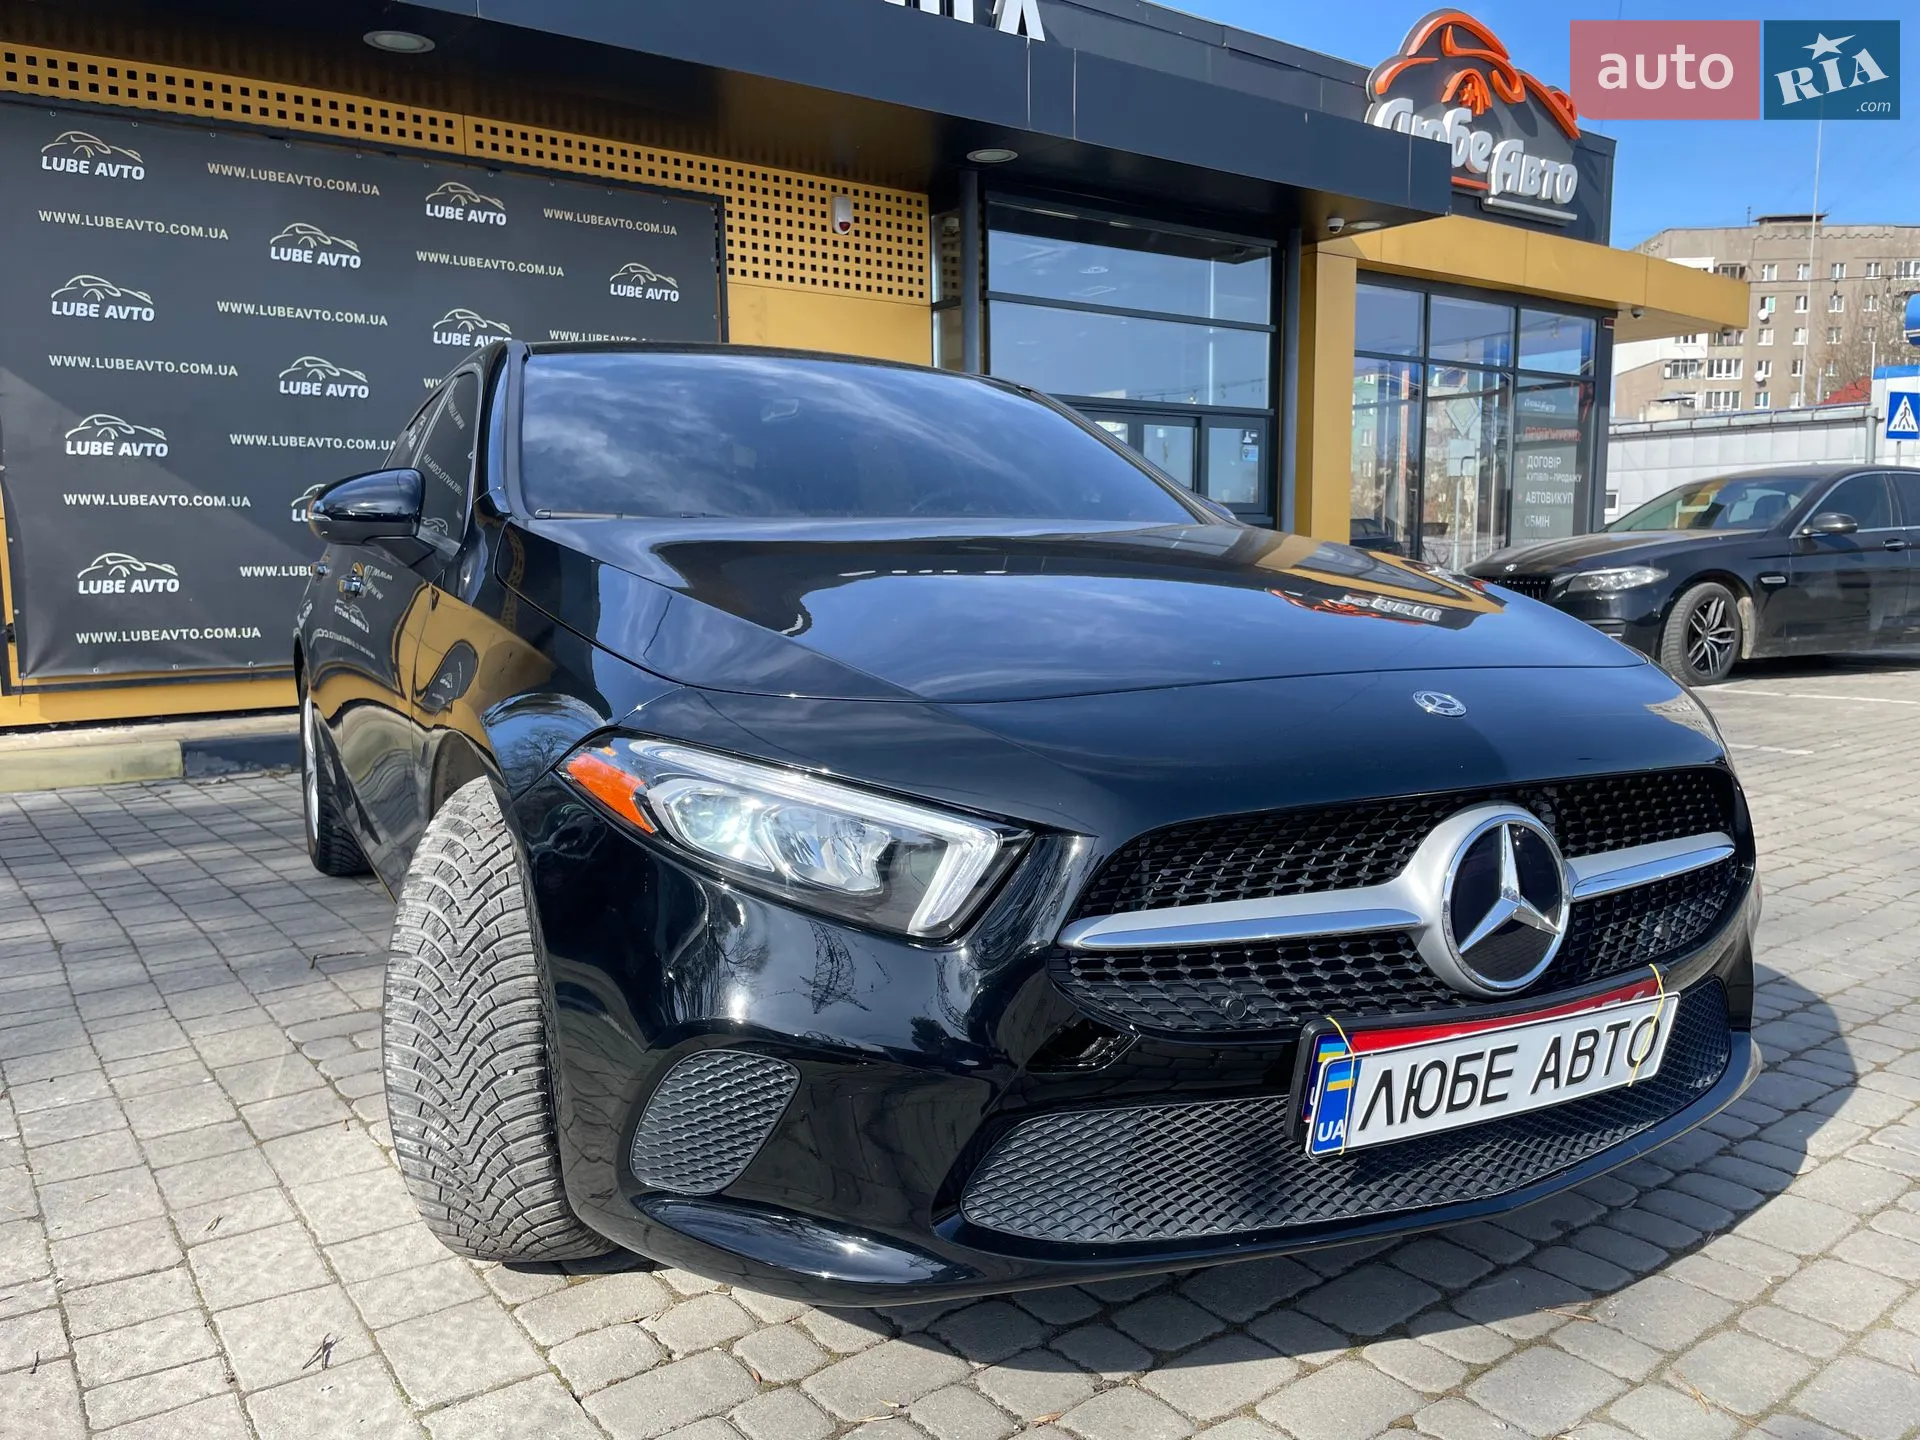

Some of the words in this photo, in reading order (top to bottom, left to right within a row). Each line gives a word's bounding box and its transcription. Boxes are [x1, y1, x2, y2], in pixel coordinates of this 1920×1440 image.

[41, 155, 89, 175] LUBE
[94, 162, 145, 181] AVTO
[207, 162, 380, 196] WWW.LUBEAVTO.COM.UA
[38, 210, 229, 241] WWW.LUBEAVTO.COM.UA
[425, 203, 465, 221] LUBE
[467, 209, 507, 226] AVTO
[543, 208, 678, 236] WWW.LUBEAVTO.COM.UA
[270, 247, 313, 264] LUBE
[317, 252, 362, 269] AVTO
[416, 251, 565, 277] WWW.LUBEAVTO.COM.UA
[610, 284, 643, 299] LUBE
[645, 287, 680, 303] AVTO
[51, 300, 99, 318] LUBE
[105, 305, 155, 322] AVTO
[217, 301, 388, 326] WWW.LUBEAVTO.COM.UA
[433, 331, 471, 347] LUBE
[48, 354, 238, 377] WWW.LUBEAVTO.COM.UA
[279, 380, 322, 397] LUBE
[325, 384, 370, 399] AVTO
[66, 440, 113, 456] LUBE
[118, 442, 169, 457] AVTO
[1526, 455, 1562, 470] ДОГОВІР
[63, 494, 251, 508] WWW.LUBEAVTO.COM.UA
[1525, 491, 1574, 505] АВТОВИКУП
[78, 579, 125, 595] LUBE
[130, 578, 180, 593] AVTO
[76, 627, 262, 644] WWW.LUBEAVTO.COM.UA
[1358, 1044, 1519, 1131] ЛЮБЕ
[1530, 1015, 1661, 1096] АВТО
[1317, 1119, 1345, 1142] UA
